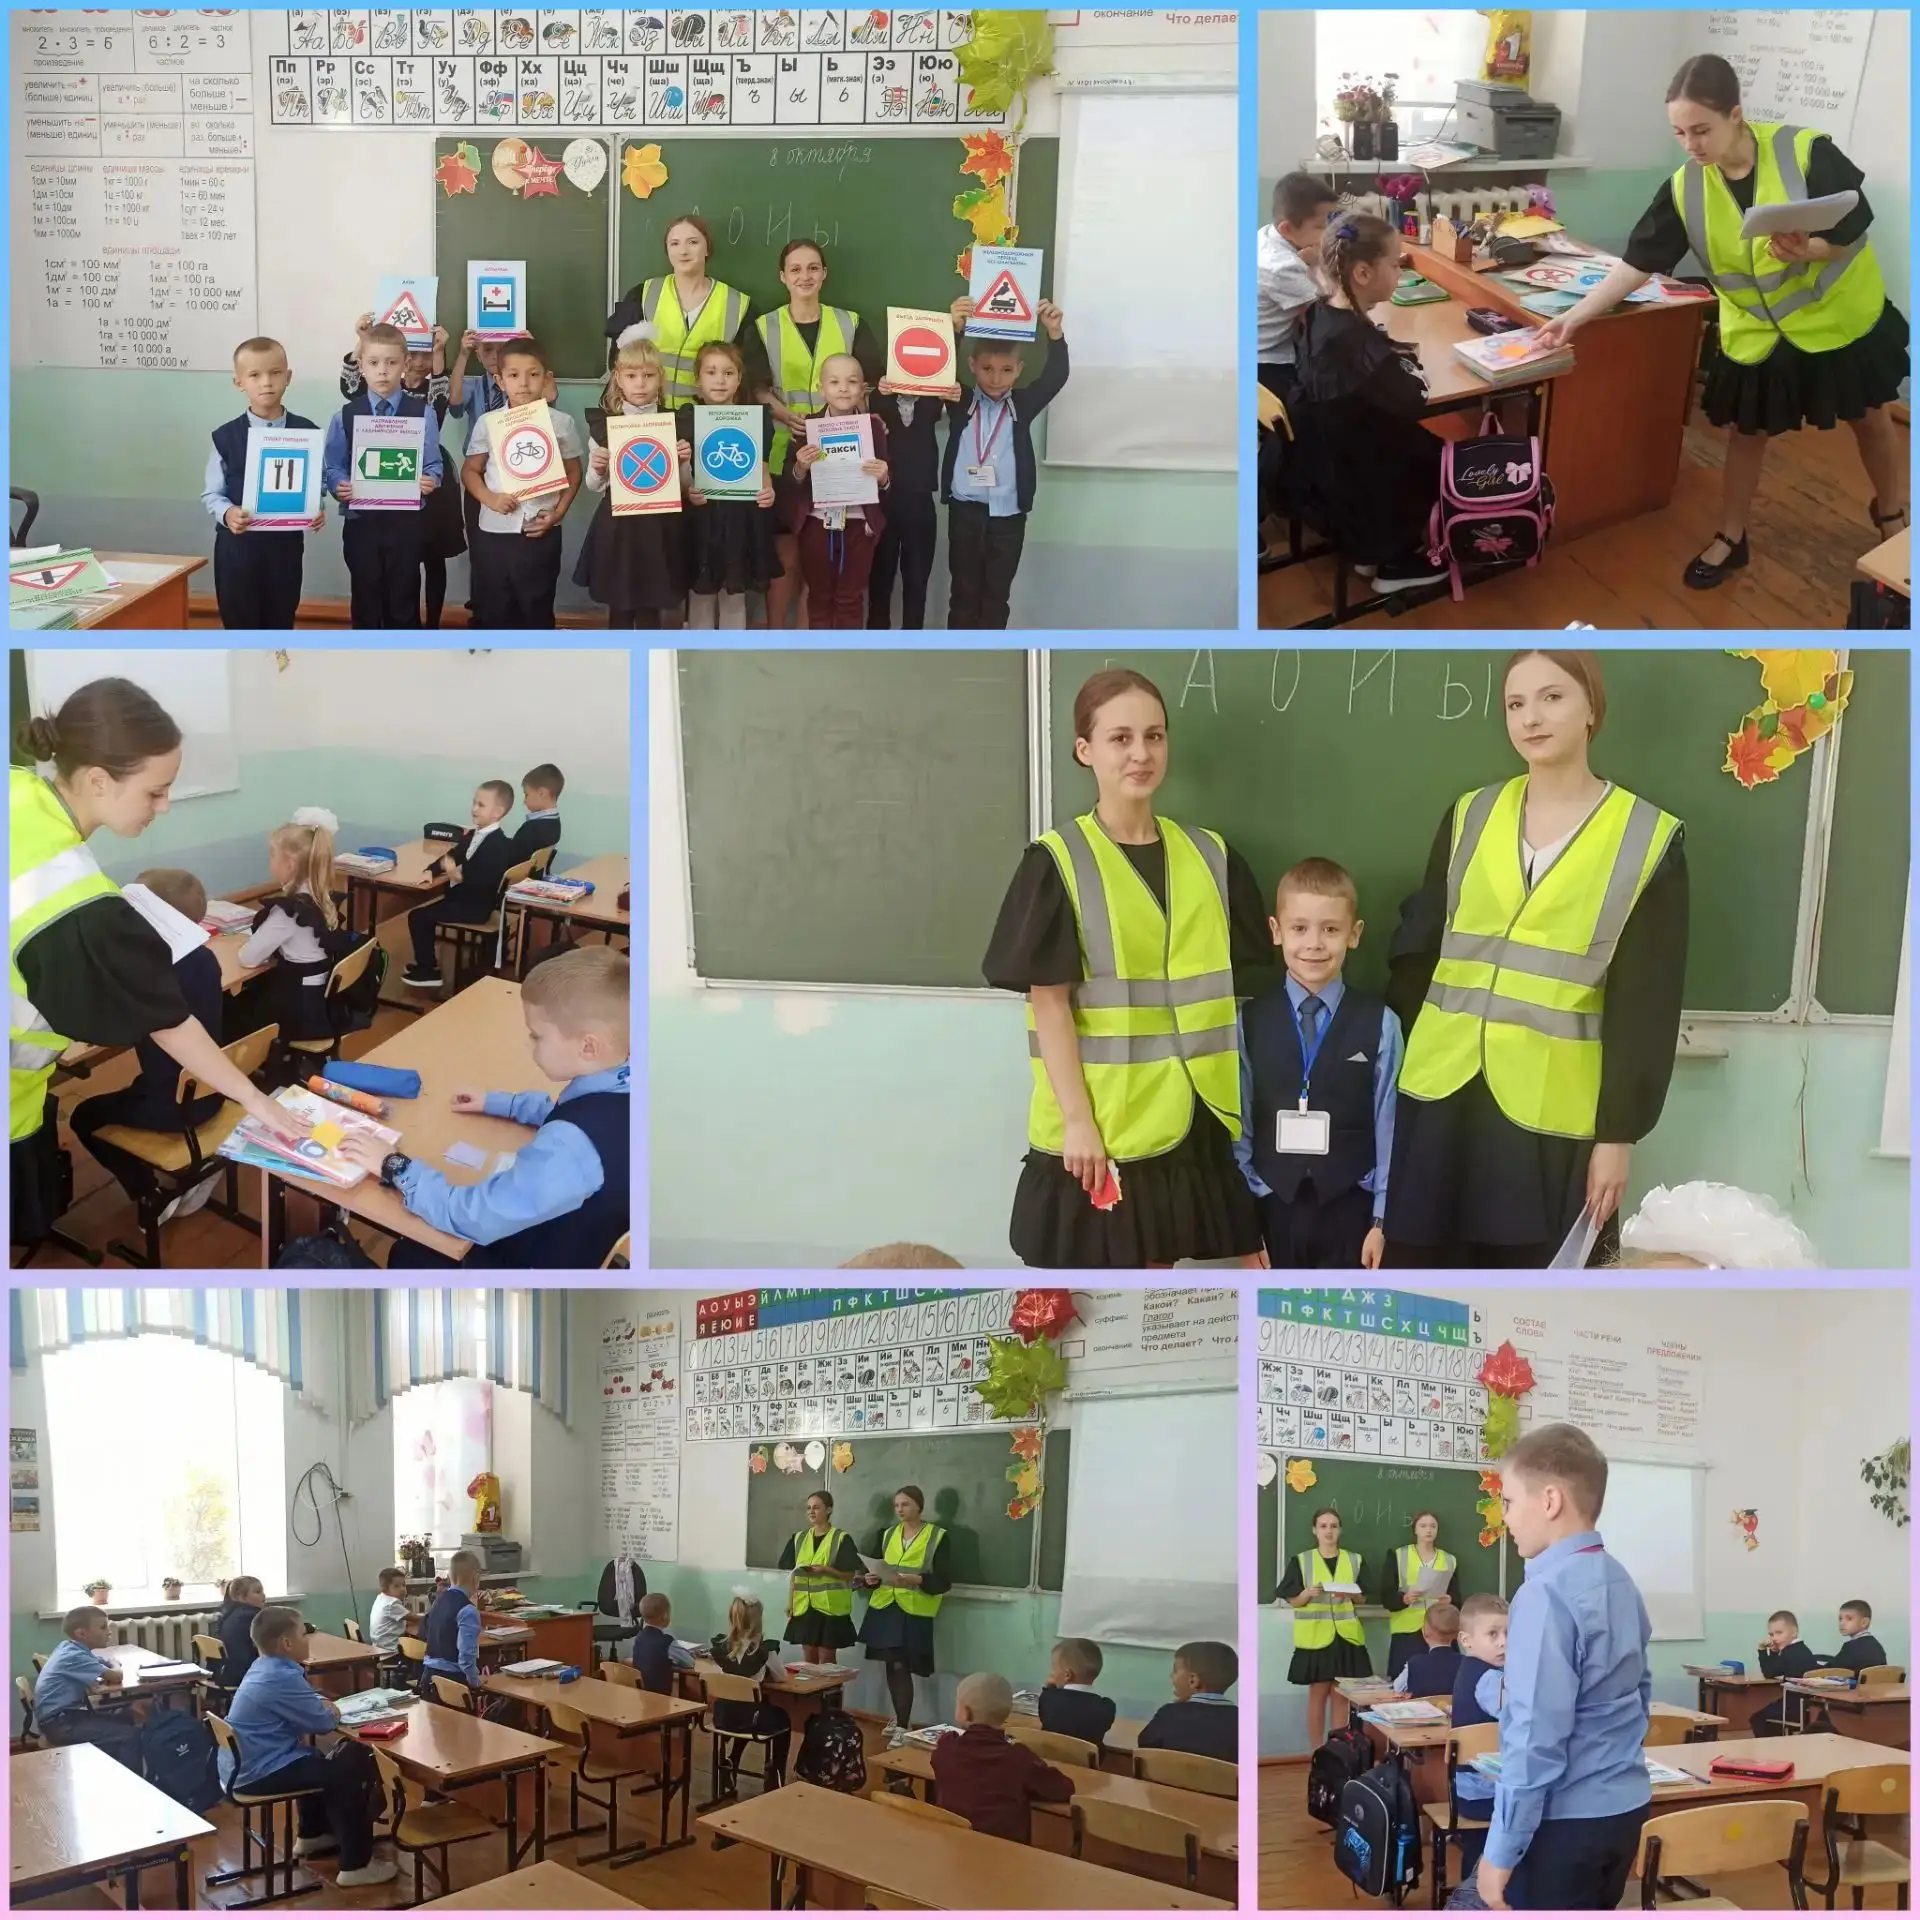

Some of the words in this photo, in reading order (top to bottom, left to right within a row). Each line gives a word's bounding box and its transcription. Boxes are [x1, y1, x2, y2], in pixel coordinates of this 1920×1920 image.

[1166, 14, 1191, 24] Что
[1194, 15, 1239, 25] делае
[38, 36, 48, 49] 2
[69, 36, 78, 49] 3
[104, 36, 113, 49] 6
[149, 36, 158, 48] 6
[180, 35, 189, 49] 2
[216, 35, 225, 48] 3
[276, 61, 296, 75] Пп
[316, 60, 336, 75] Рр
[354, 60, 375, 74] Сс
[396, 60, 414, 74] Тт
[438, 60, 457, 78] Уу
[479, 60, 508, 77] Фф
[521, 60, 542, 74] Хх
[563, 60, 588, 77] Цц
[607, 60, 629, 74] Чч
[649, 60, 679, 74] Шш
[693, 59, 725, 76] Щщ
[736, 59, 751, 73] Ъ
[781, 58, 798, 72] Ы
[827, 58, 839, 72] Ь
[872, 57, 896, 71] Ээ
[918, 56, 953, 71] Юю
[203, 78, 240, 86] сколько
[190, 90, 226, 98] больше
[190, 103, 228, 111] меньше
[81, 259, 100, 269] 100
[82, 273, 101, 282] 100
[825, 445, 857, 454] такси
[1456, 464, 1499, 481] Lovely
[1475, 474, 1505, 490] Girl
[698, 1304, 706, 1315] А
[710, 1302, 719, 1313] О
[723, 1300, 731, 1311] У
[735, 1297, 744, 1308] Ы
[748, 1294, 757, 1306] Э
[832, 1298, 841, 1311] П
[847, 1296, 858, 1308] Ф
[864, 1294, 873, 1306] К
[880, 1291, 888, 1303] Т
[699, 1324, 706, 1334] Я
[711, 1319, 718, 1333] Ё
[721, 1319, 731, 1330] Ю
[735, 1317, 743, 1328] И
[749, 1315, 755, 1326] Е
[755, 1333, 765, 1359] 5
[800, 1326, 809, 1354] 8
[829, 1317, 844, 1349] 10
[848, 1315, 861, 1347] 11
[864, 1313, 880, 1344] 12
[881, 1310, 897, 1340] 13
[900, 1308, 915, 1339] 14
[919, 1303, 937, 1337] 15
[939, 1300, 956, 1334] 16
[960, 1298, 979, 1331] 17
[981, 1294, 1000, 1329] 18
[1207, 1314, 1239, 1327] дейст
[1281, 1302, 1292, 1314] П
[1301, 1304, 1314, 1317] Ф
[1323, 1308, 1333, 1321] К
[1343, 1311, 1353, 1323] Т
[1361, 1314, 1376, 1327] Ш
[1382, 1316, 1393, 1330] С
[1401, 1320, 1411, 1333] Х
[1419, 1322, 1430, 1336] Ц
[1439, 1325, 1448, 1338] Ч
[1452, 1328, 1467, 1342] Щ
[1141, 1343, 1159, 1353] Что
[1212, 1334, 1232, 1344] Что
[1259, 1321, 1272, 1352] 9
[1278, 1322, 1296, 1355] 10
[1302, 1325, 1318, 1357] 11
[1323, 1328, 1342, 1362] 12
[1345, 1331, 1363, 1364] 13
[1368, 1333, 1384, 1366] 14
[1388, 1339, 1404, 1370] 15
[1407, 1342, 1424, 1372] 16
[1428, 1345, 1445, 1376] 17
[1448, 1348, 1464, 1379] 18
[1467, 1351, 1482, 1380] 19
[1261, 1361, 1282, 1373] Жж
[1290, 1367, 1303, 1376] Зз
[1316, 1369, 1331, 1379] Ии
[1370, 1375, 1383, 1386] Кк
[1421, 1383, 1437, 1392] Мм
[1444, 1386, 1457, 1395] Нн
[1275, 1406, 1291, 1417] Чч
[1303, 1409, 1323, 1420] Шш
[1331, 1412, 1351, 1424] Щщ
[1357, 1416, 1367, 1425] Ъ
[1383, 1418, 1393, 1428] Ы
[1432, 1424, 1446, 1433] Ээ
[1456, 1426, 1474, 1436] Юю
